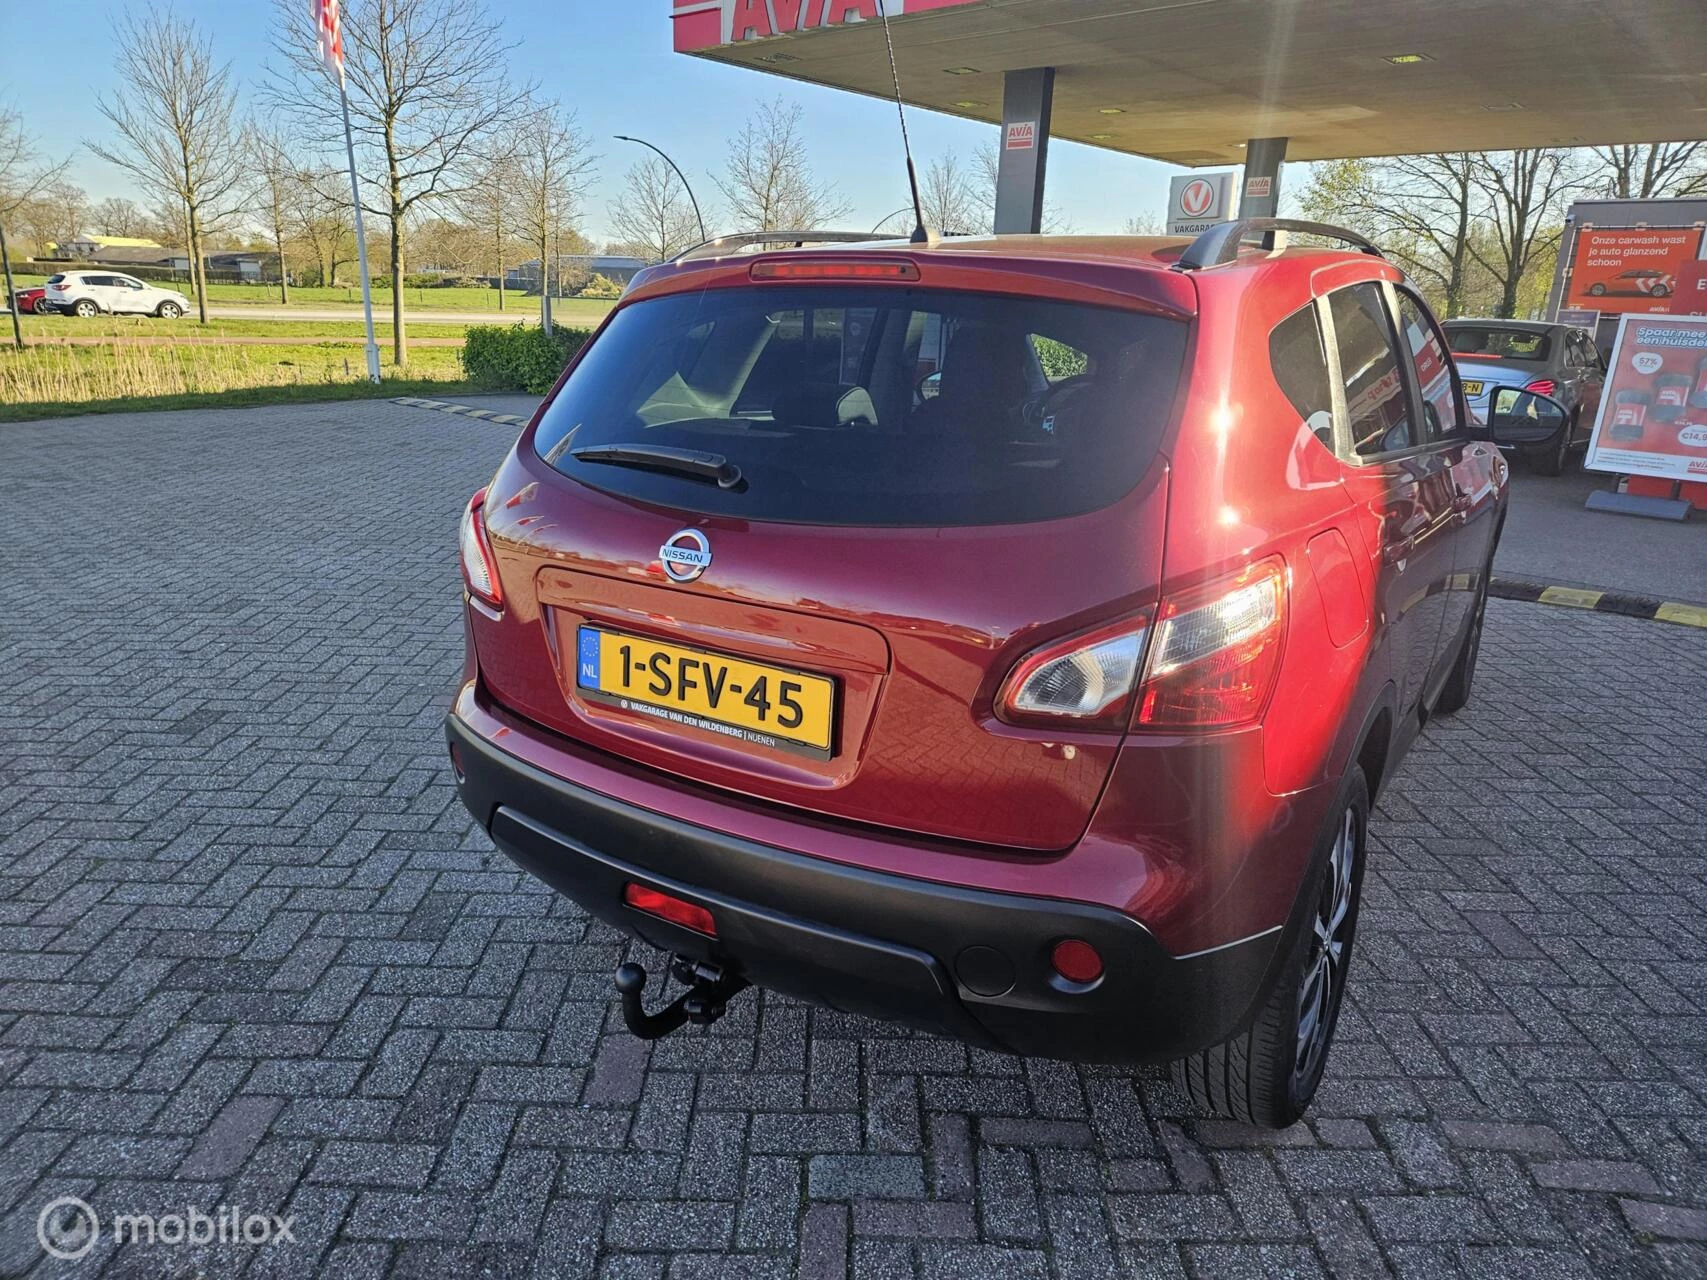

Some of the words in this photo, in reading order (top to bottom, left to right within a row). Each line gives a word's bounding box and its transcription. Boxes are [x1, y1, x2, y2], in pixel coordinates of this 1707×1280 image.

[1008, 123, 1033, 137] AVIA
[1248, 178, 1269, 188] AVIA
[1175, 224, 1215, 233] VAKGARA
[1591, 236, 1616, 245] Onze
[1618, 235, 1659, 245] carwash
[1662, 236, 1686, 244] wast
[1588, 248, 1598, 257] je
[1623, 247, 1668, 257] glanzend
[1587, 258, 1621, 266] schoon
[1638, 327, 1676, 338] Spaar
[1678, 330, 1706, 338] mee
[1637, 336, 1660, 344] een
[662, 548, 704, 563] NISSAN
[582, 664, 597, 679] NL
[619, 645, 803, 728] 1-SFV-45
[631, 702, 668, 718] VAKGARAGE
[669, 712, 682, 722] VAN
[684, 716, 697, 726] DEN
[699, 719, 742, 738] WILDENBERG
[748, 732, 775, 747] NUENEN
